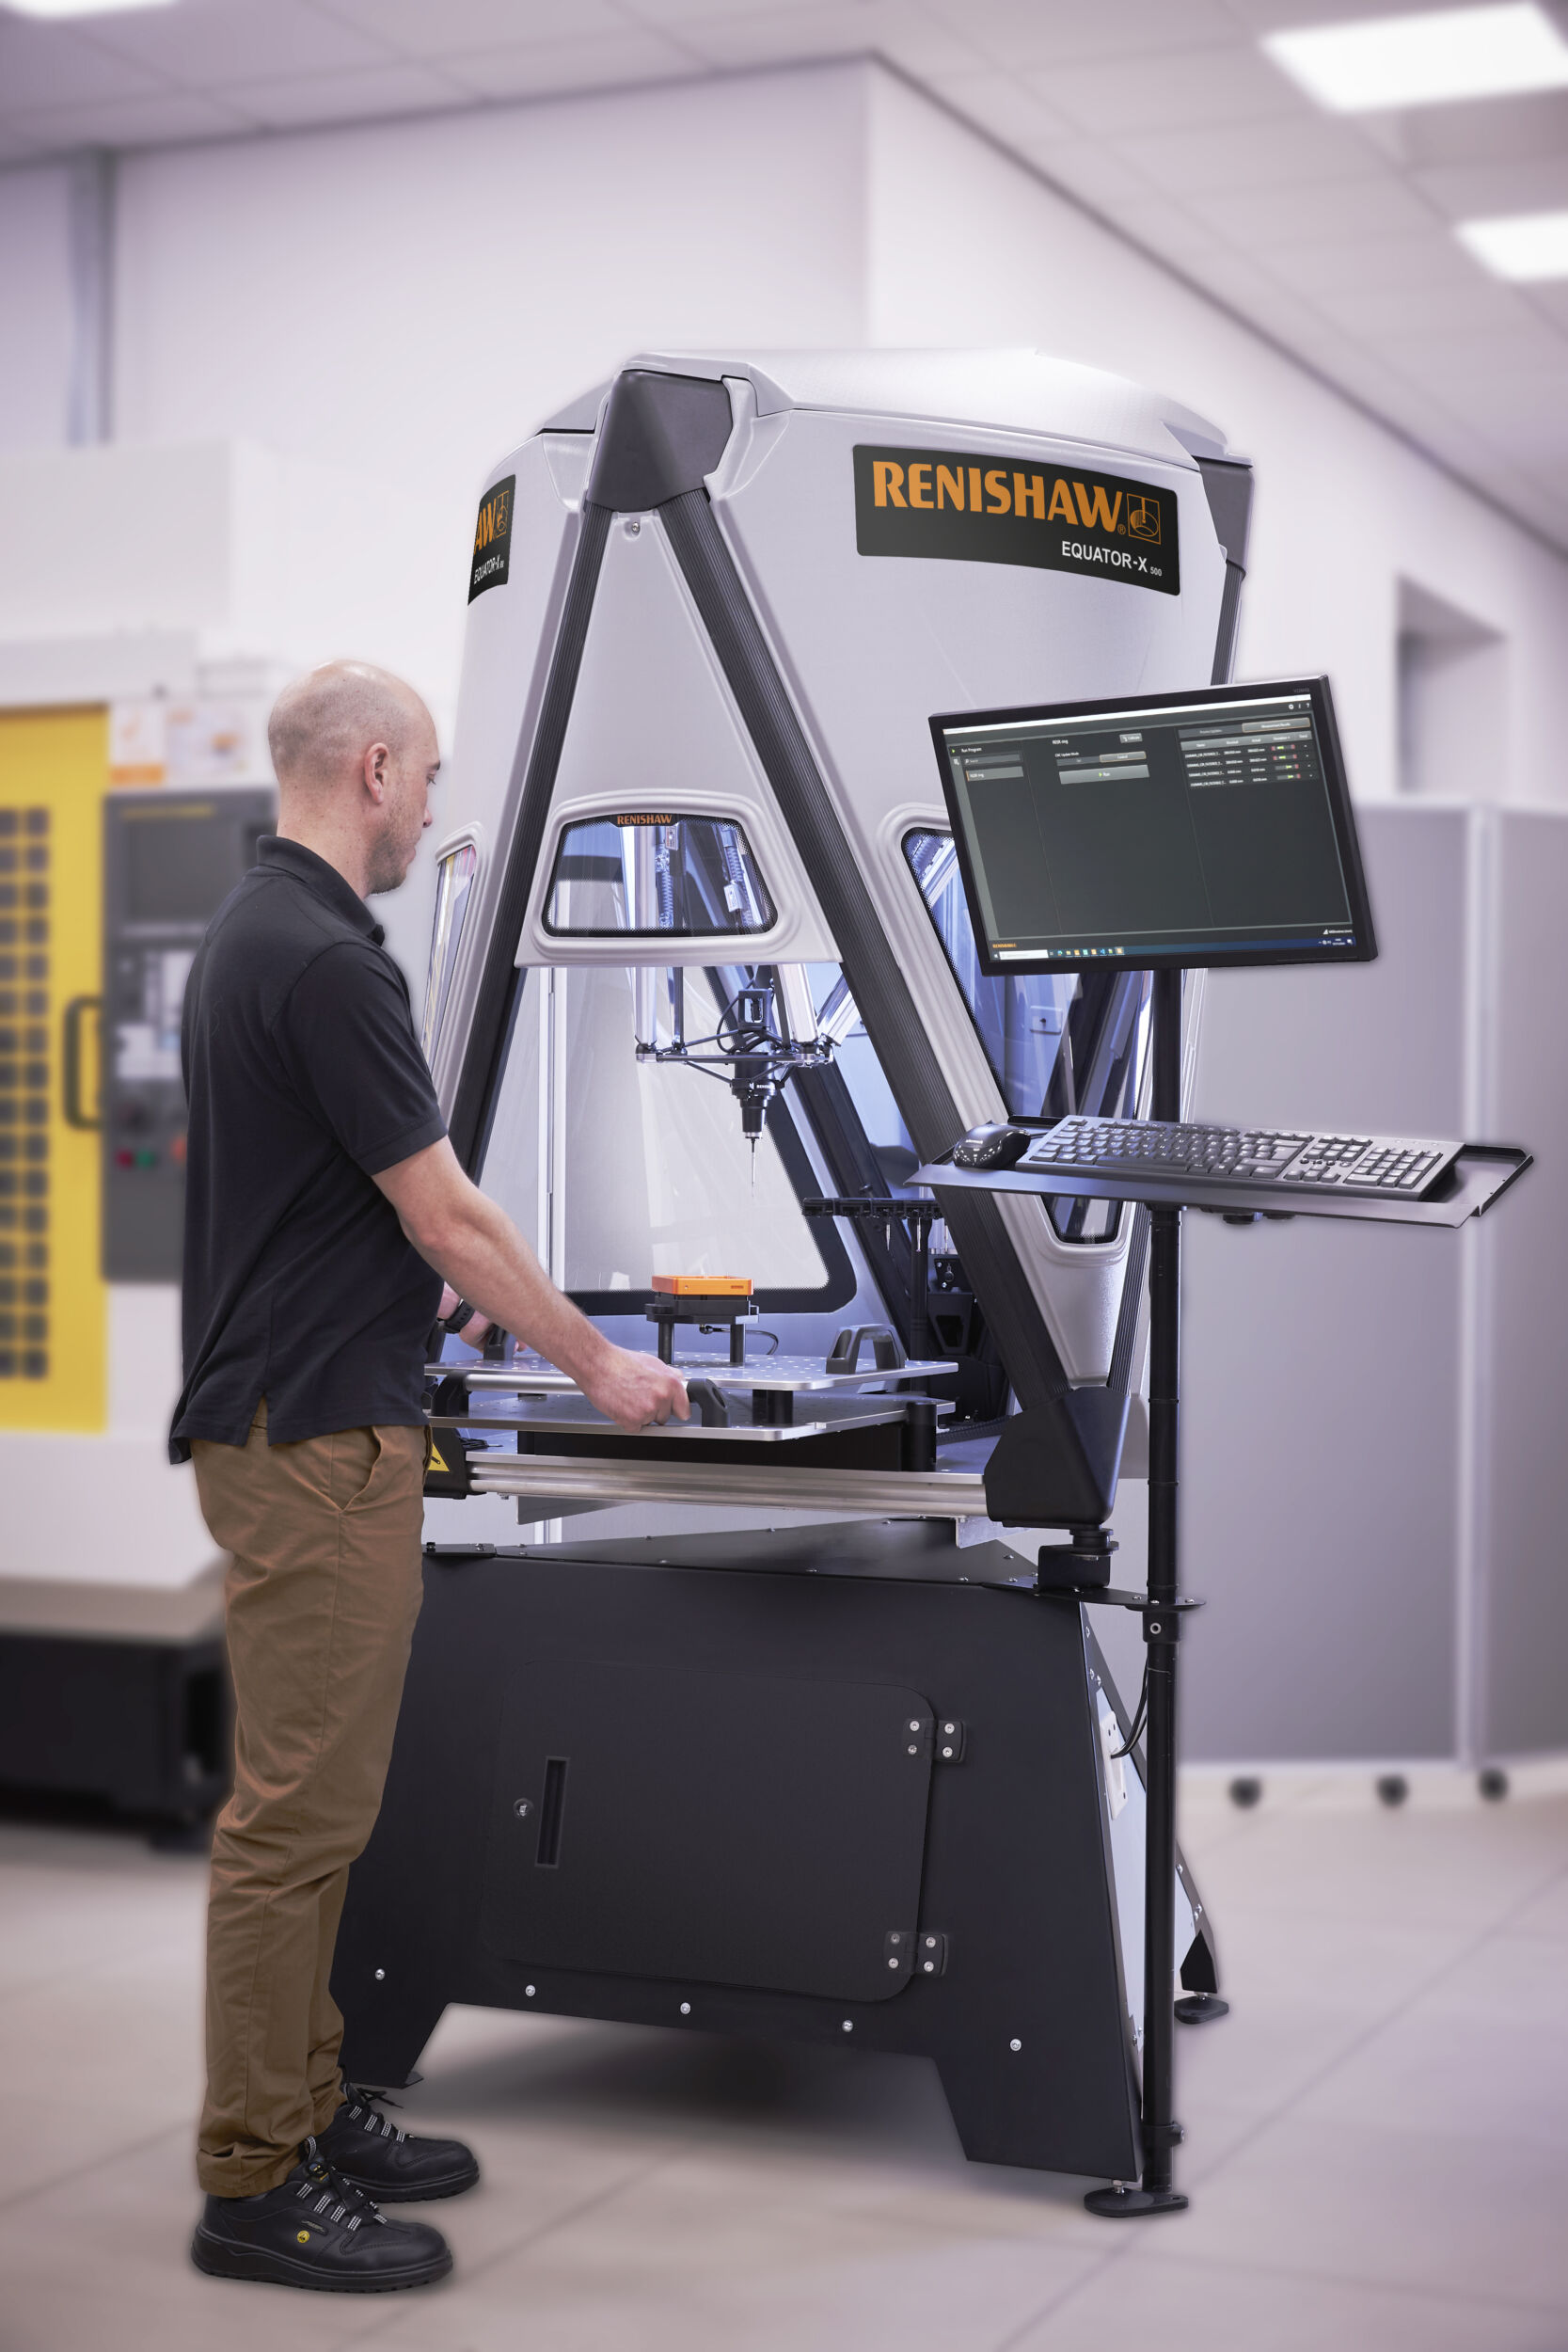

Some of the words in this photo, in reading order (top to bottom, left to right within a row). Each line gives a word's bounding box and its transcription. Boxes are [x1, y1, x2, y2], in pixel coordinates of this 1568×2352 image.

[873, 461, 1123, 532] RENISHAW
[1062, 540, 1148, 573] EQUATOR-X
[1149, 566, 1163, 577] 500
[617, 814, 672, 825] RENISHAW
